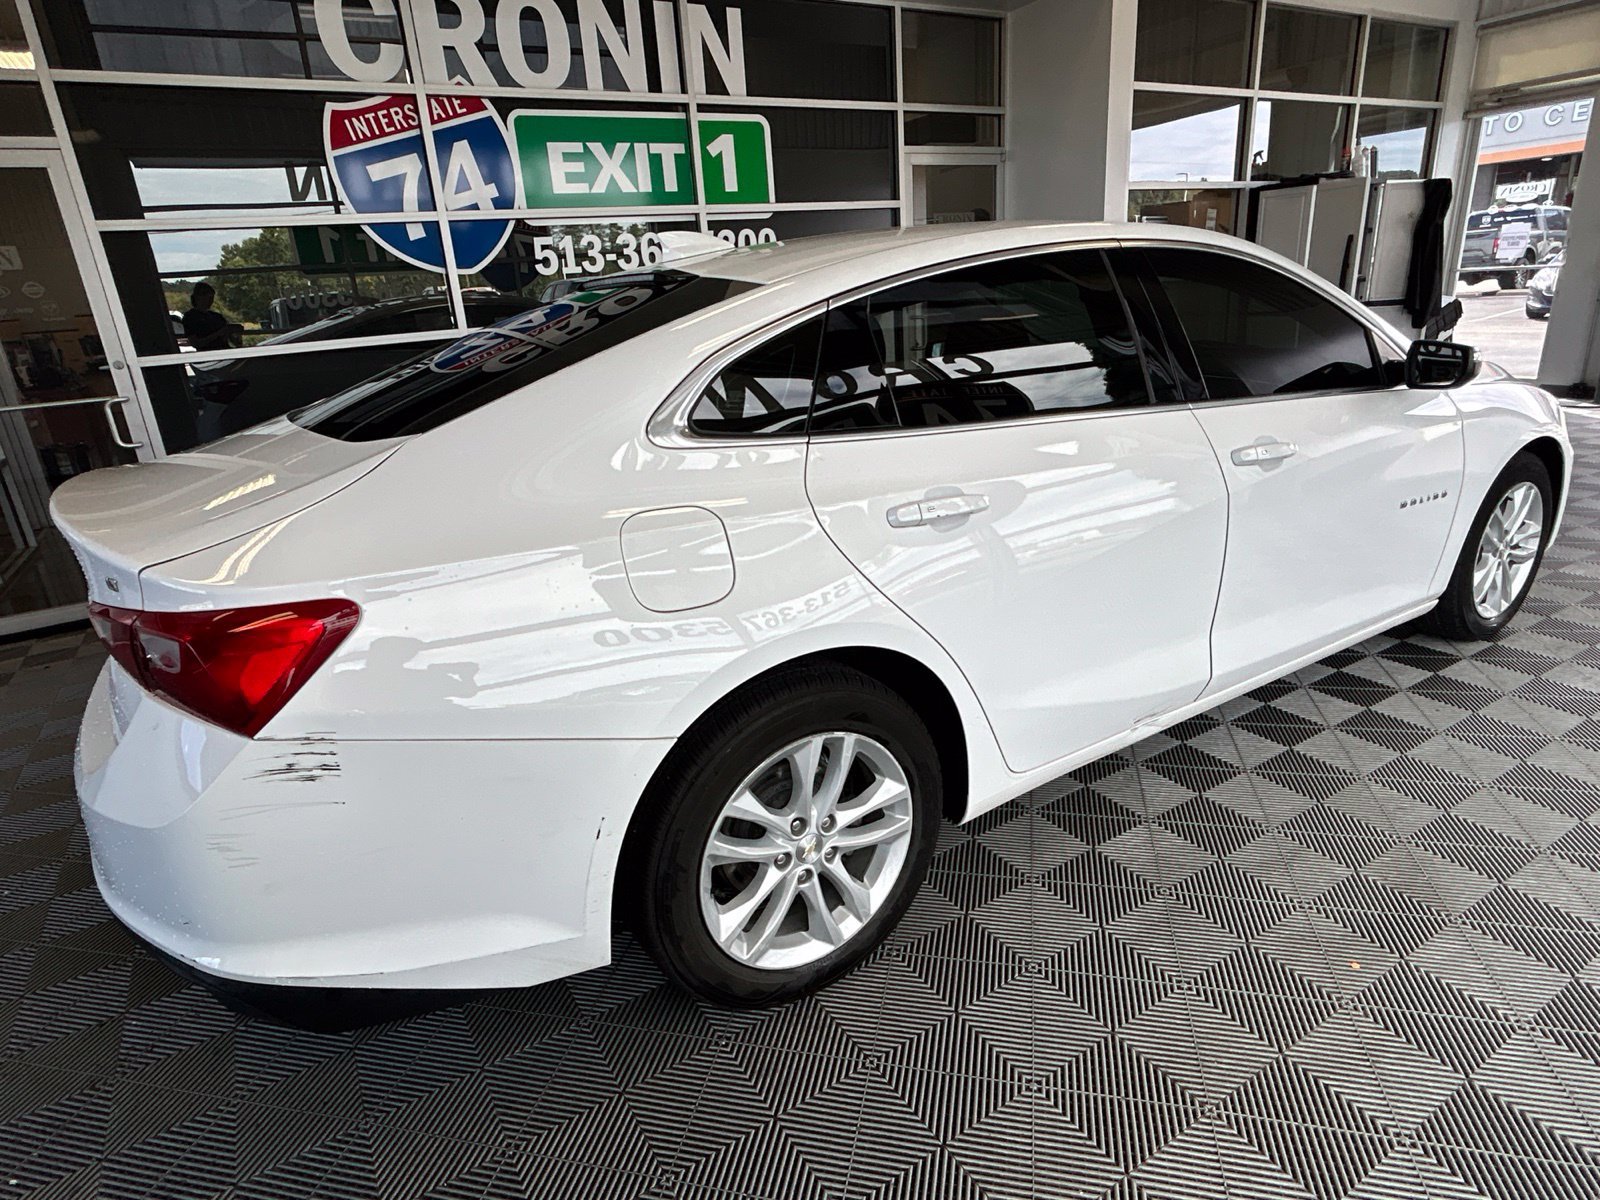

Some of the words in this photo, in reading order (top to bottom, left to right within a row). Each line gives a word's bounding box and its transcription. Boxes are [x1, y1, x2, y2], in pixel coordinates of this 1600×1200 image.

[314, 0, 747, 97] CRONIN
[344, 95, 468, 142] INTERSATE
[366, 139, 499, 242] 74
[546, 141, 686, 194] EXIT
[706, 133, 739, 193] 1
